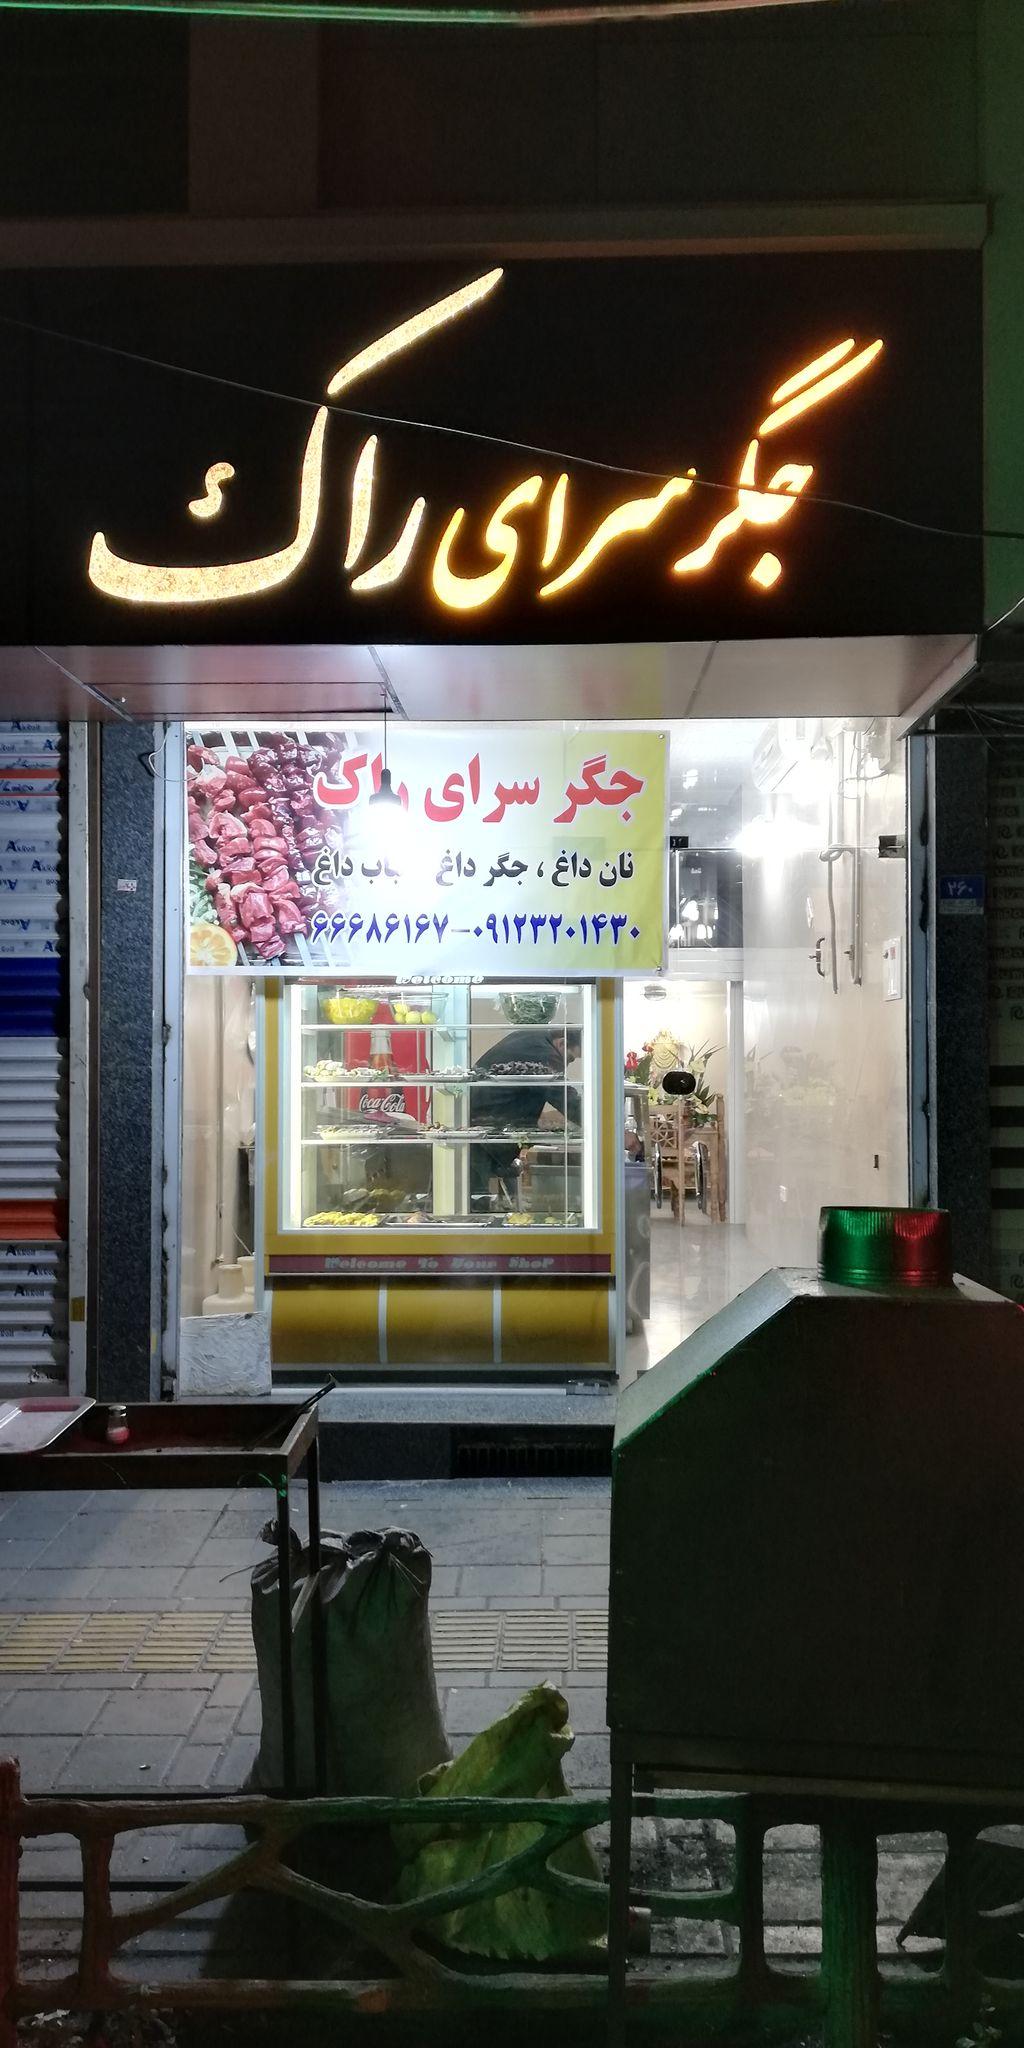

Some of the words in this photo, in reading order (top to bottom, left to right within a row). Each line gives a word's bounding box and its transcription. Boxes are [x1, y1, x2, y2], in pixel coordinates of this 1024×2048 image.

[674, 338, 884, 590] جگر
[431, 467, 698, 610] سرای
[424, 752, 540, 823] سرای
[553, 754, 644, 823] جگر
[313, 848, 354, 886] داغ
[435, 848, 477, 887] داغ
[483, 852, 529, 887] جگر
[551, 849, 592, 887] داغ
[599, 851, 634, 887] نان
[324, 1256, 407, 1269] Welcome
[418, 1256, 439, 1269] To
